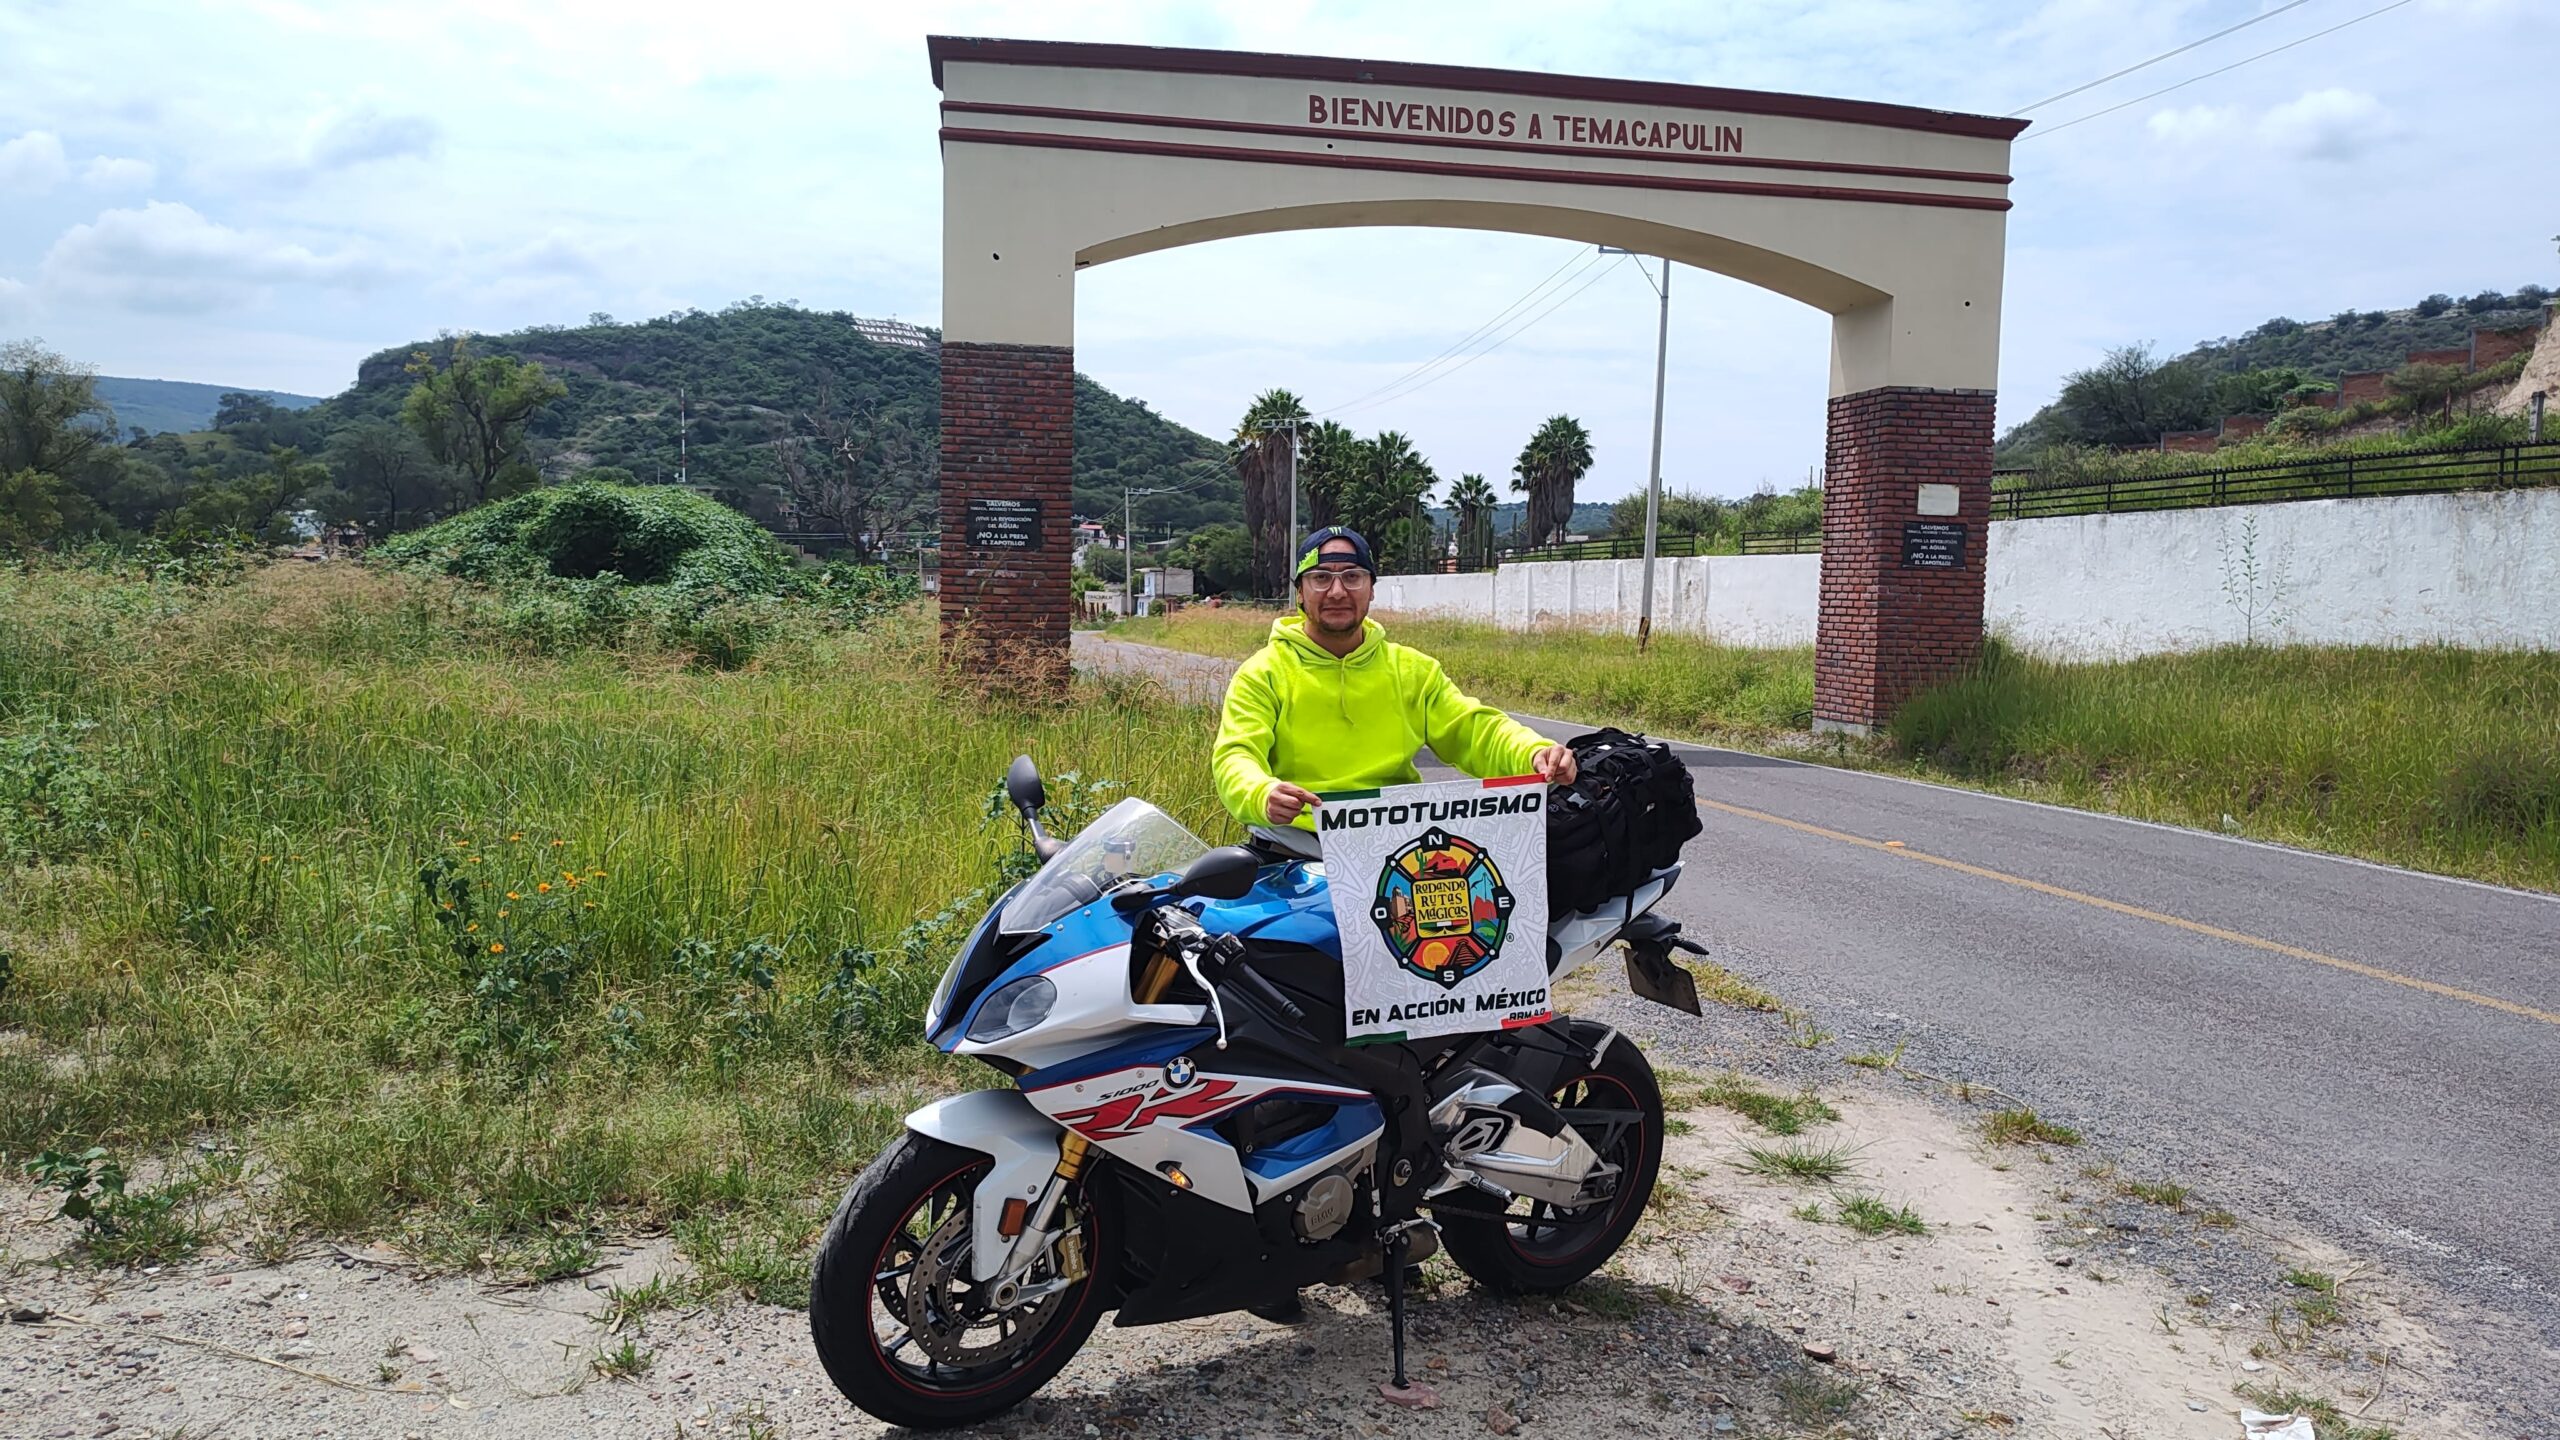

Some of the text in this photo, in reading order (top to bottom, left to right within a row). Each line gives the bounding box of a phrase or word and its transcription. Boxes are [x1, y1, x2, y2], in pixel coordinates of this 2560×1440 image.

[1308, 94, 1743, 153] BIENVENIDOS A TEMACAPULIN
[851, 325, 928, 339] TEMACAPULIN
[1321, 792, 1542, 832] MOTOTURISMO
[1428, 834, 1443, 846] N
[1498, 897, 1510, 908] E
[1375, 908, 1388, 919] O
[1444, 971, 1455, 982] S
[1352, 987, 1547, 1026] EN ACCIÓN MÉXICO
[1096, 1079, 1160, 1102] S1000
